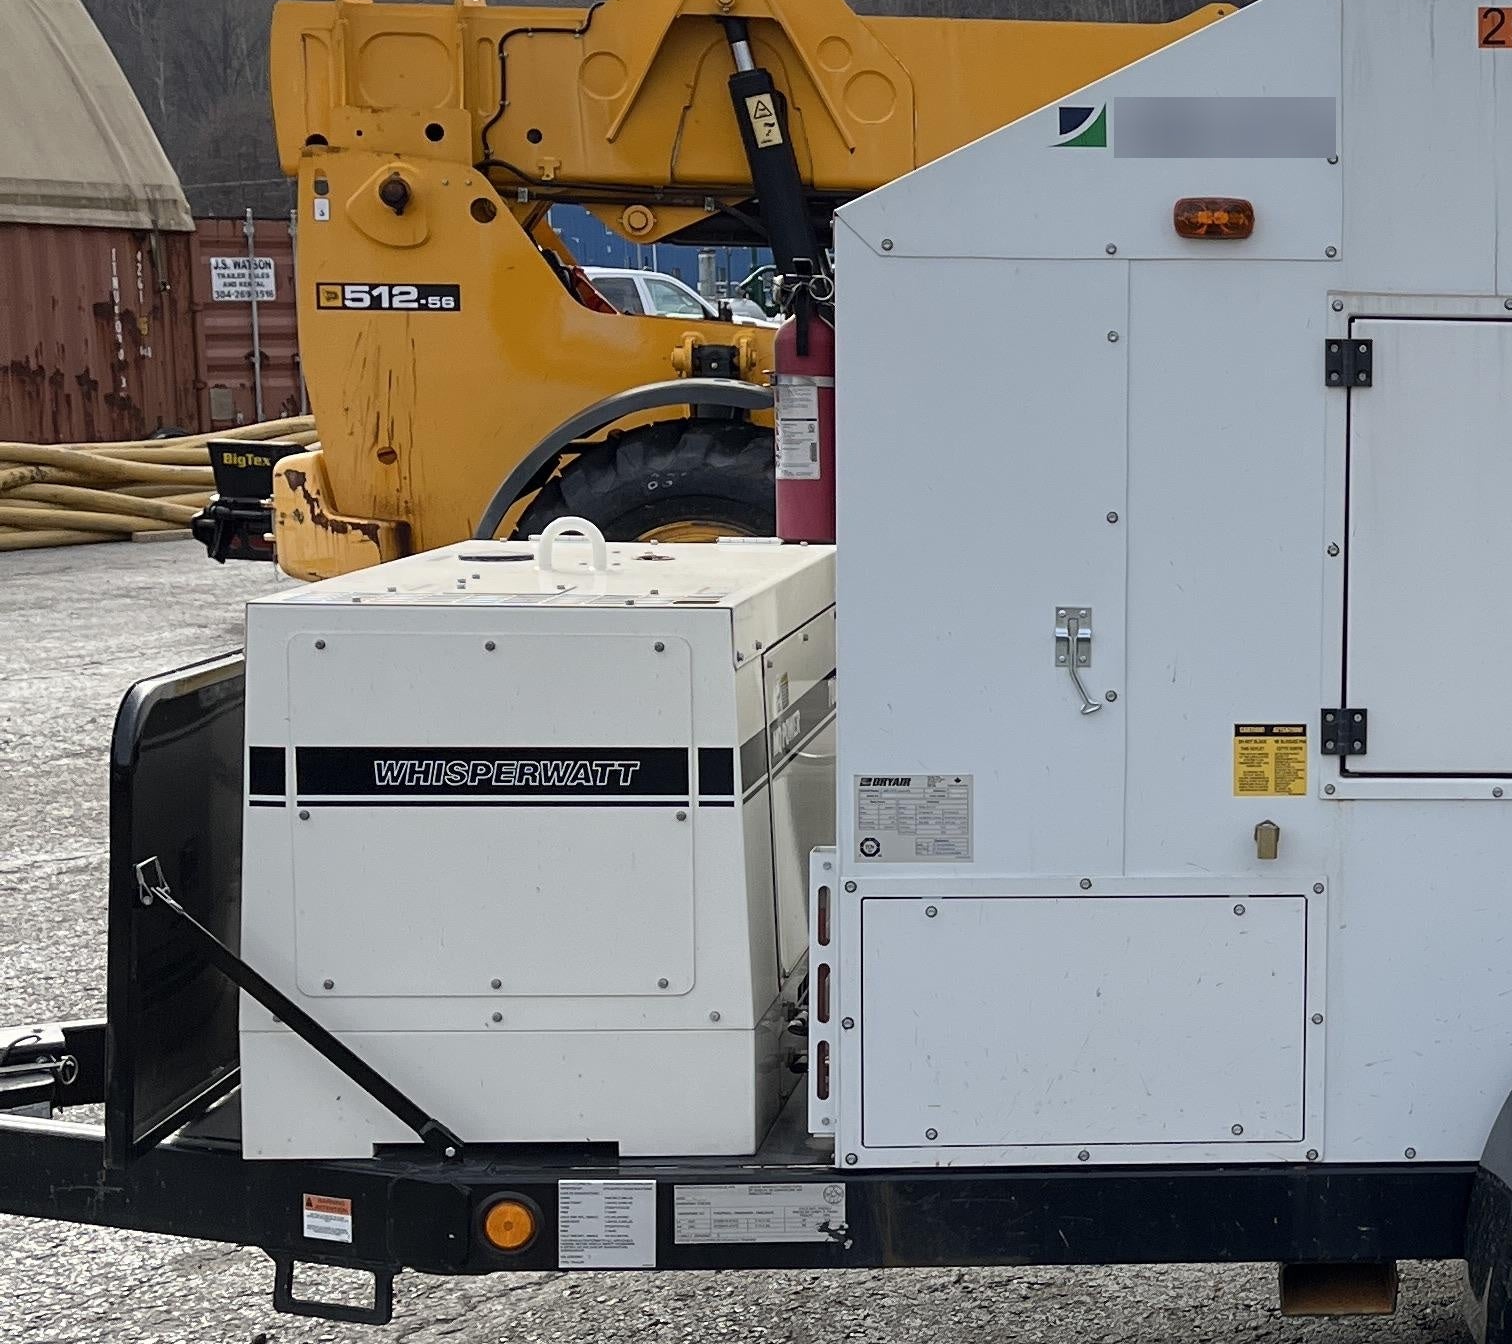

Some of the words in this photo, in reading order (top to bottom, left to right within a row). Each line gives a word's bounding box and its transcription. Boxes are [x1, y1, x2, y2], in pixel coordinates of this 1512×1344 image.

[343, 285, 455, 309] 512-56
[373, 760, 641, 786] WHISPERWATT
[872, 777, 911, 787] DRYAIR
